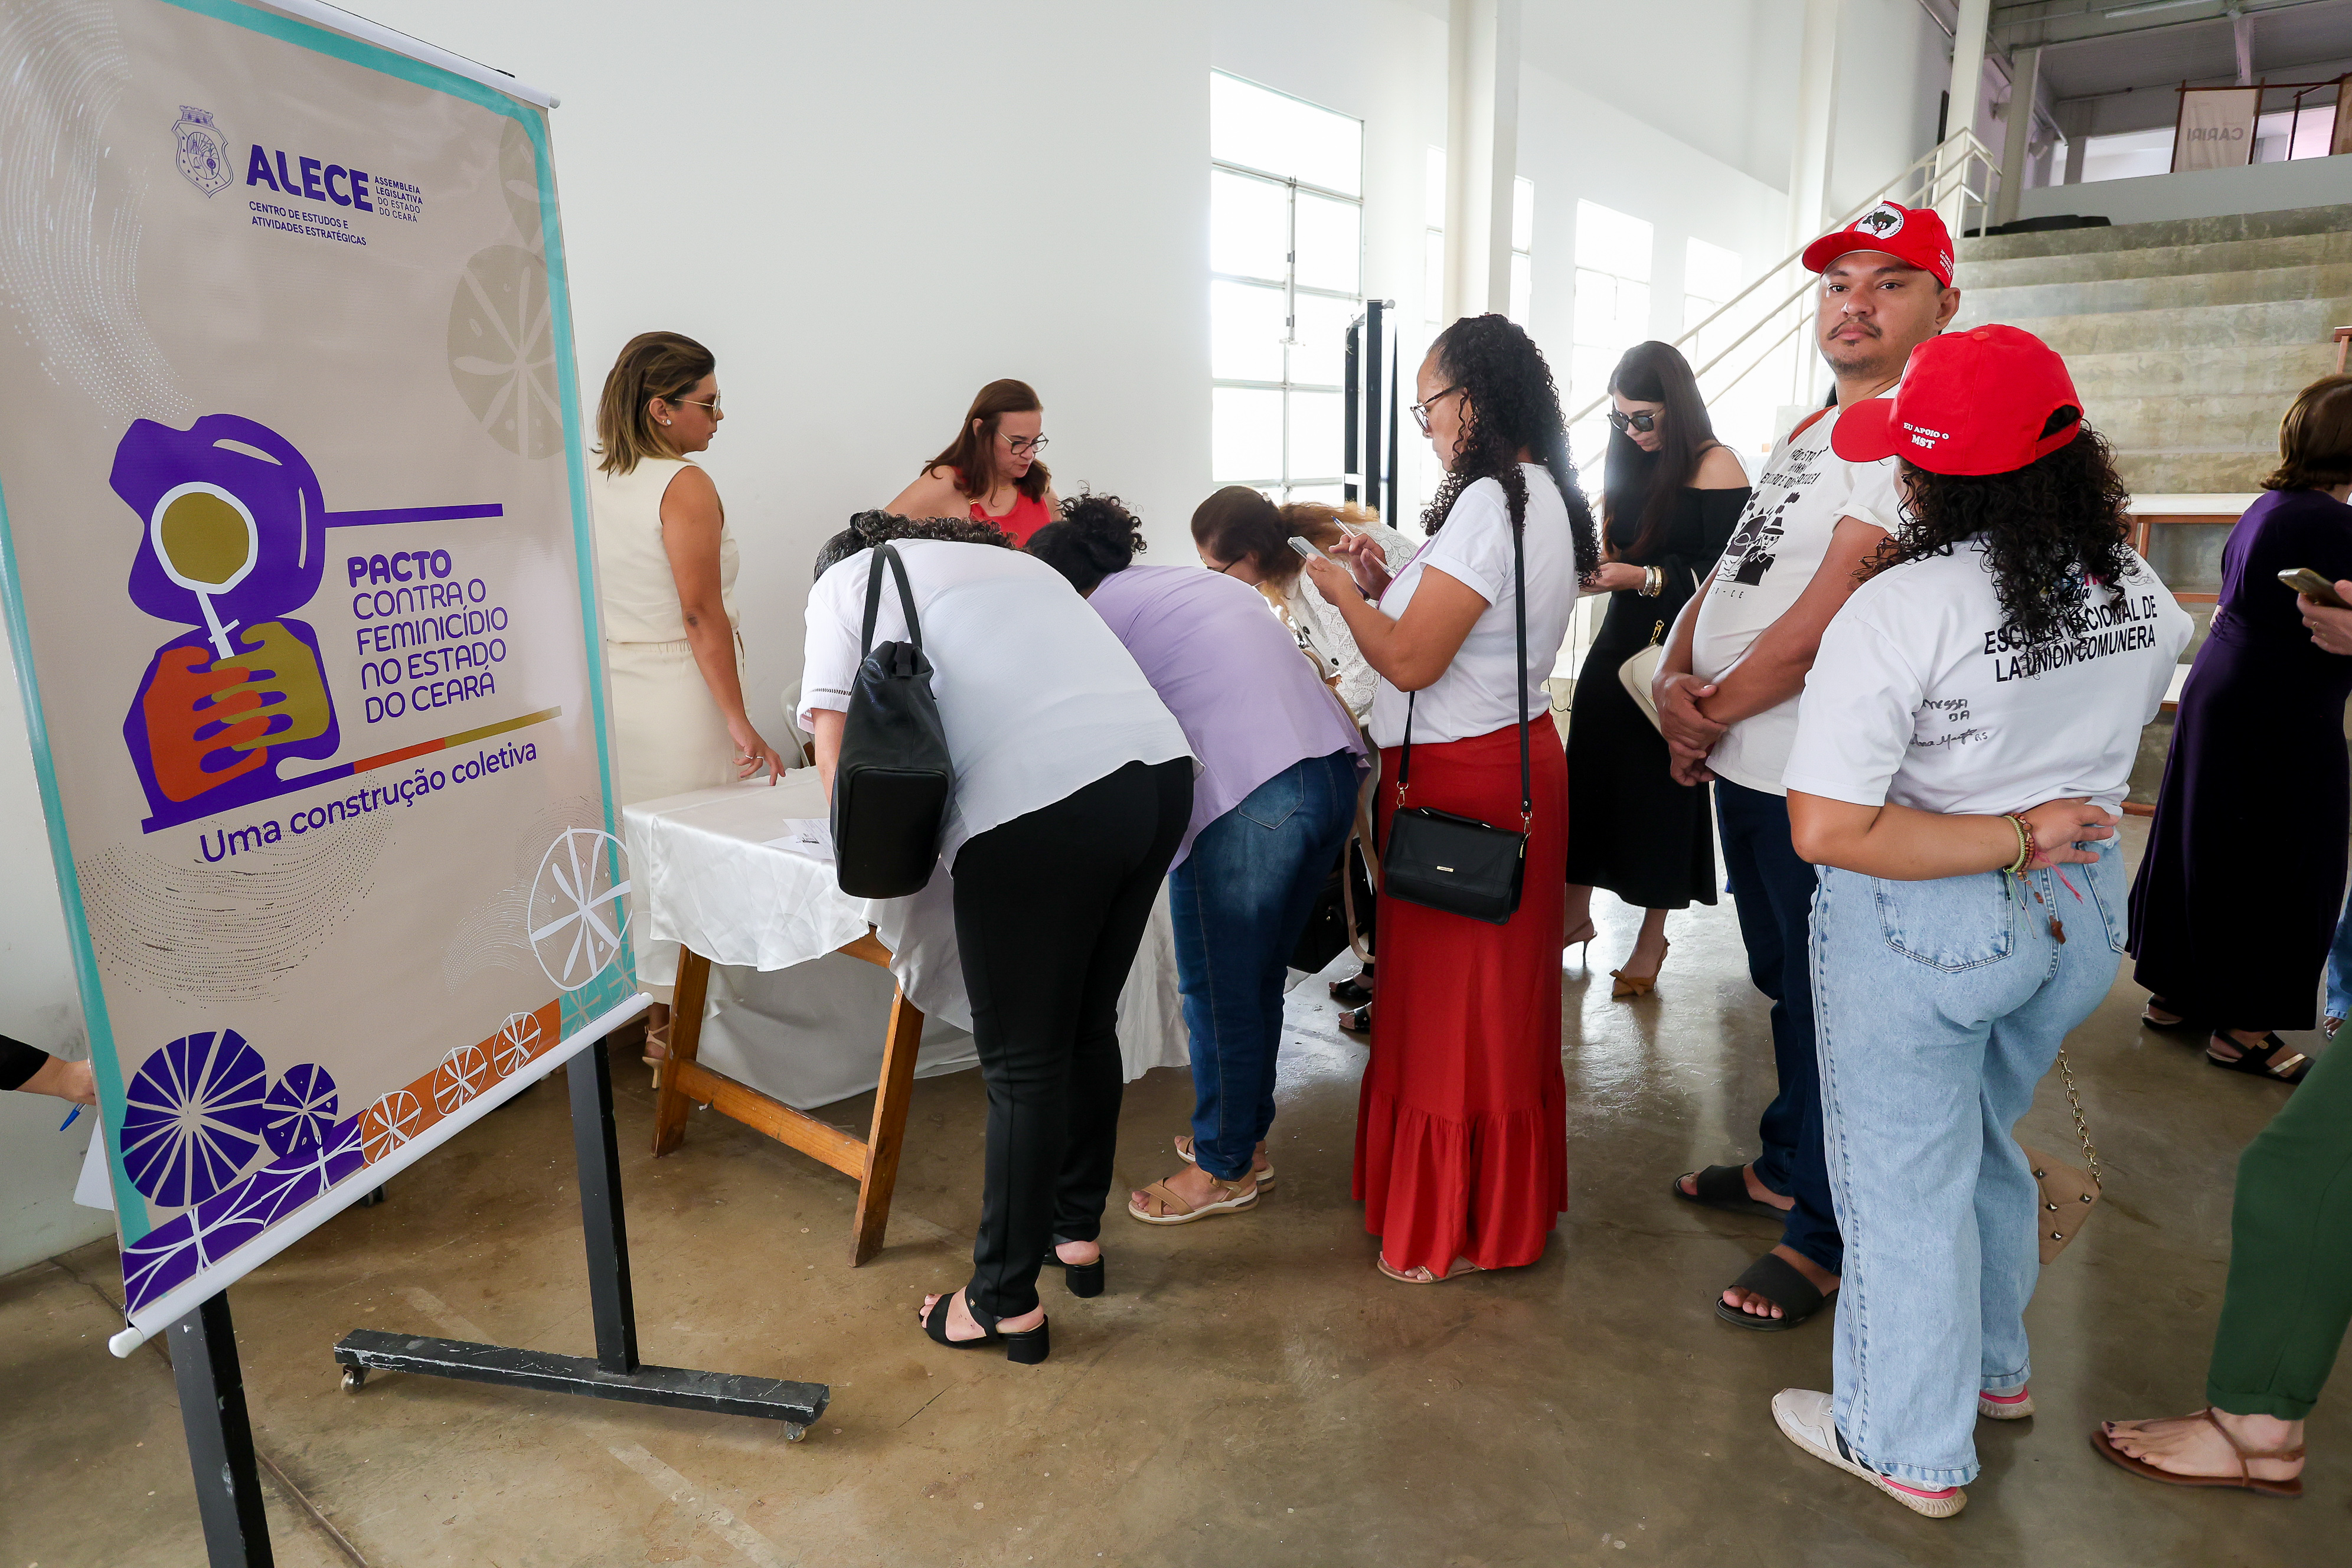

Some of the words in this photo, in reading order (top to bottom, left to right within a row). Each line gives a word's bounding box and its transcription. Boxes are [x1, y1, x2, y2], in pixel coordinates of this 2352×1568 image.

[246, 143, 373, 213] ALECE
[374, 175, 420, 194] ASSEMBLEIA
[376, 186, 423, 205] LEGISLATIVA
[249, 201, 286, 217] CENTRO
[288, 209, 300, 220] DE
[302, 212, 342, 228] ESTUDOS
[344, 220, 349, 228] E
[377, 197, 389, 207] DO
[391, 200, 420, 214] ESTADO
[379, 207, 390, 217] DO
[393, 210, 418, 223] CEARÁ
[251, 215, 304, 234] ATIVIDADES
[306, 227, 367, 246] ESTRATÉGICAS
[1903, 422, 1913, 431] EU
[1913, 426, 1941, 438] APOIO
[1911, 434, 1935, 449] MST
[347, 549, 452, 588] PACTO
[353, 581, 463, 620] CONTRA
[468, 578, 486, 603] O
[2066, 599, 2140, 636] CIONAL
[2142, 595, 2157, 619] DE
[357, 605, 508, 655] FEMINICÍDIO
[361, 658, 401, 690] NO
[407, 638, 506, 680] ESTADO
[1995, 656, 2022, 682] LA
[2026, 641, 2074, 676] UNION
[2075, 624, 2156, 662] COMUNERA
[365, 691, 406, 724] DO
[412, 665, 495, 711] CEARÁ
[200, 819, 281, 863] Uma
[290, 768, 446, 835] construção
[450, 742, 537, 784] coletiva
